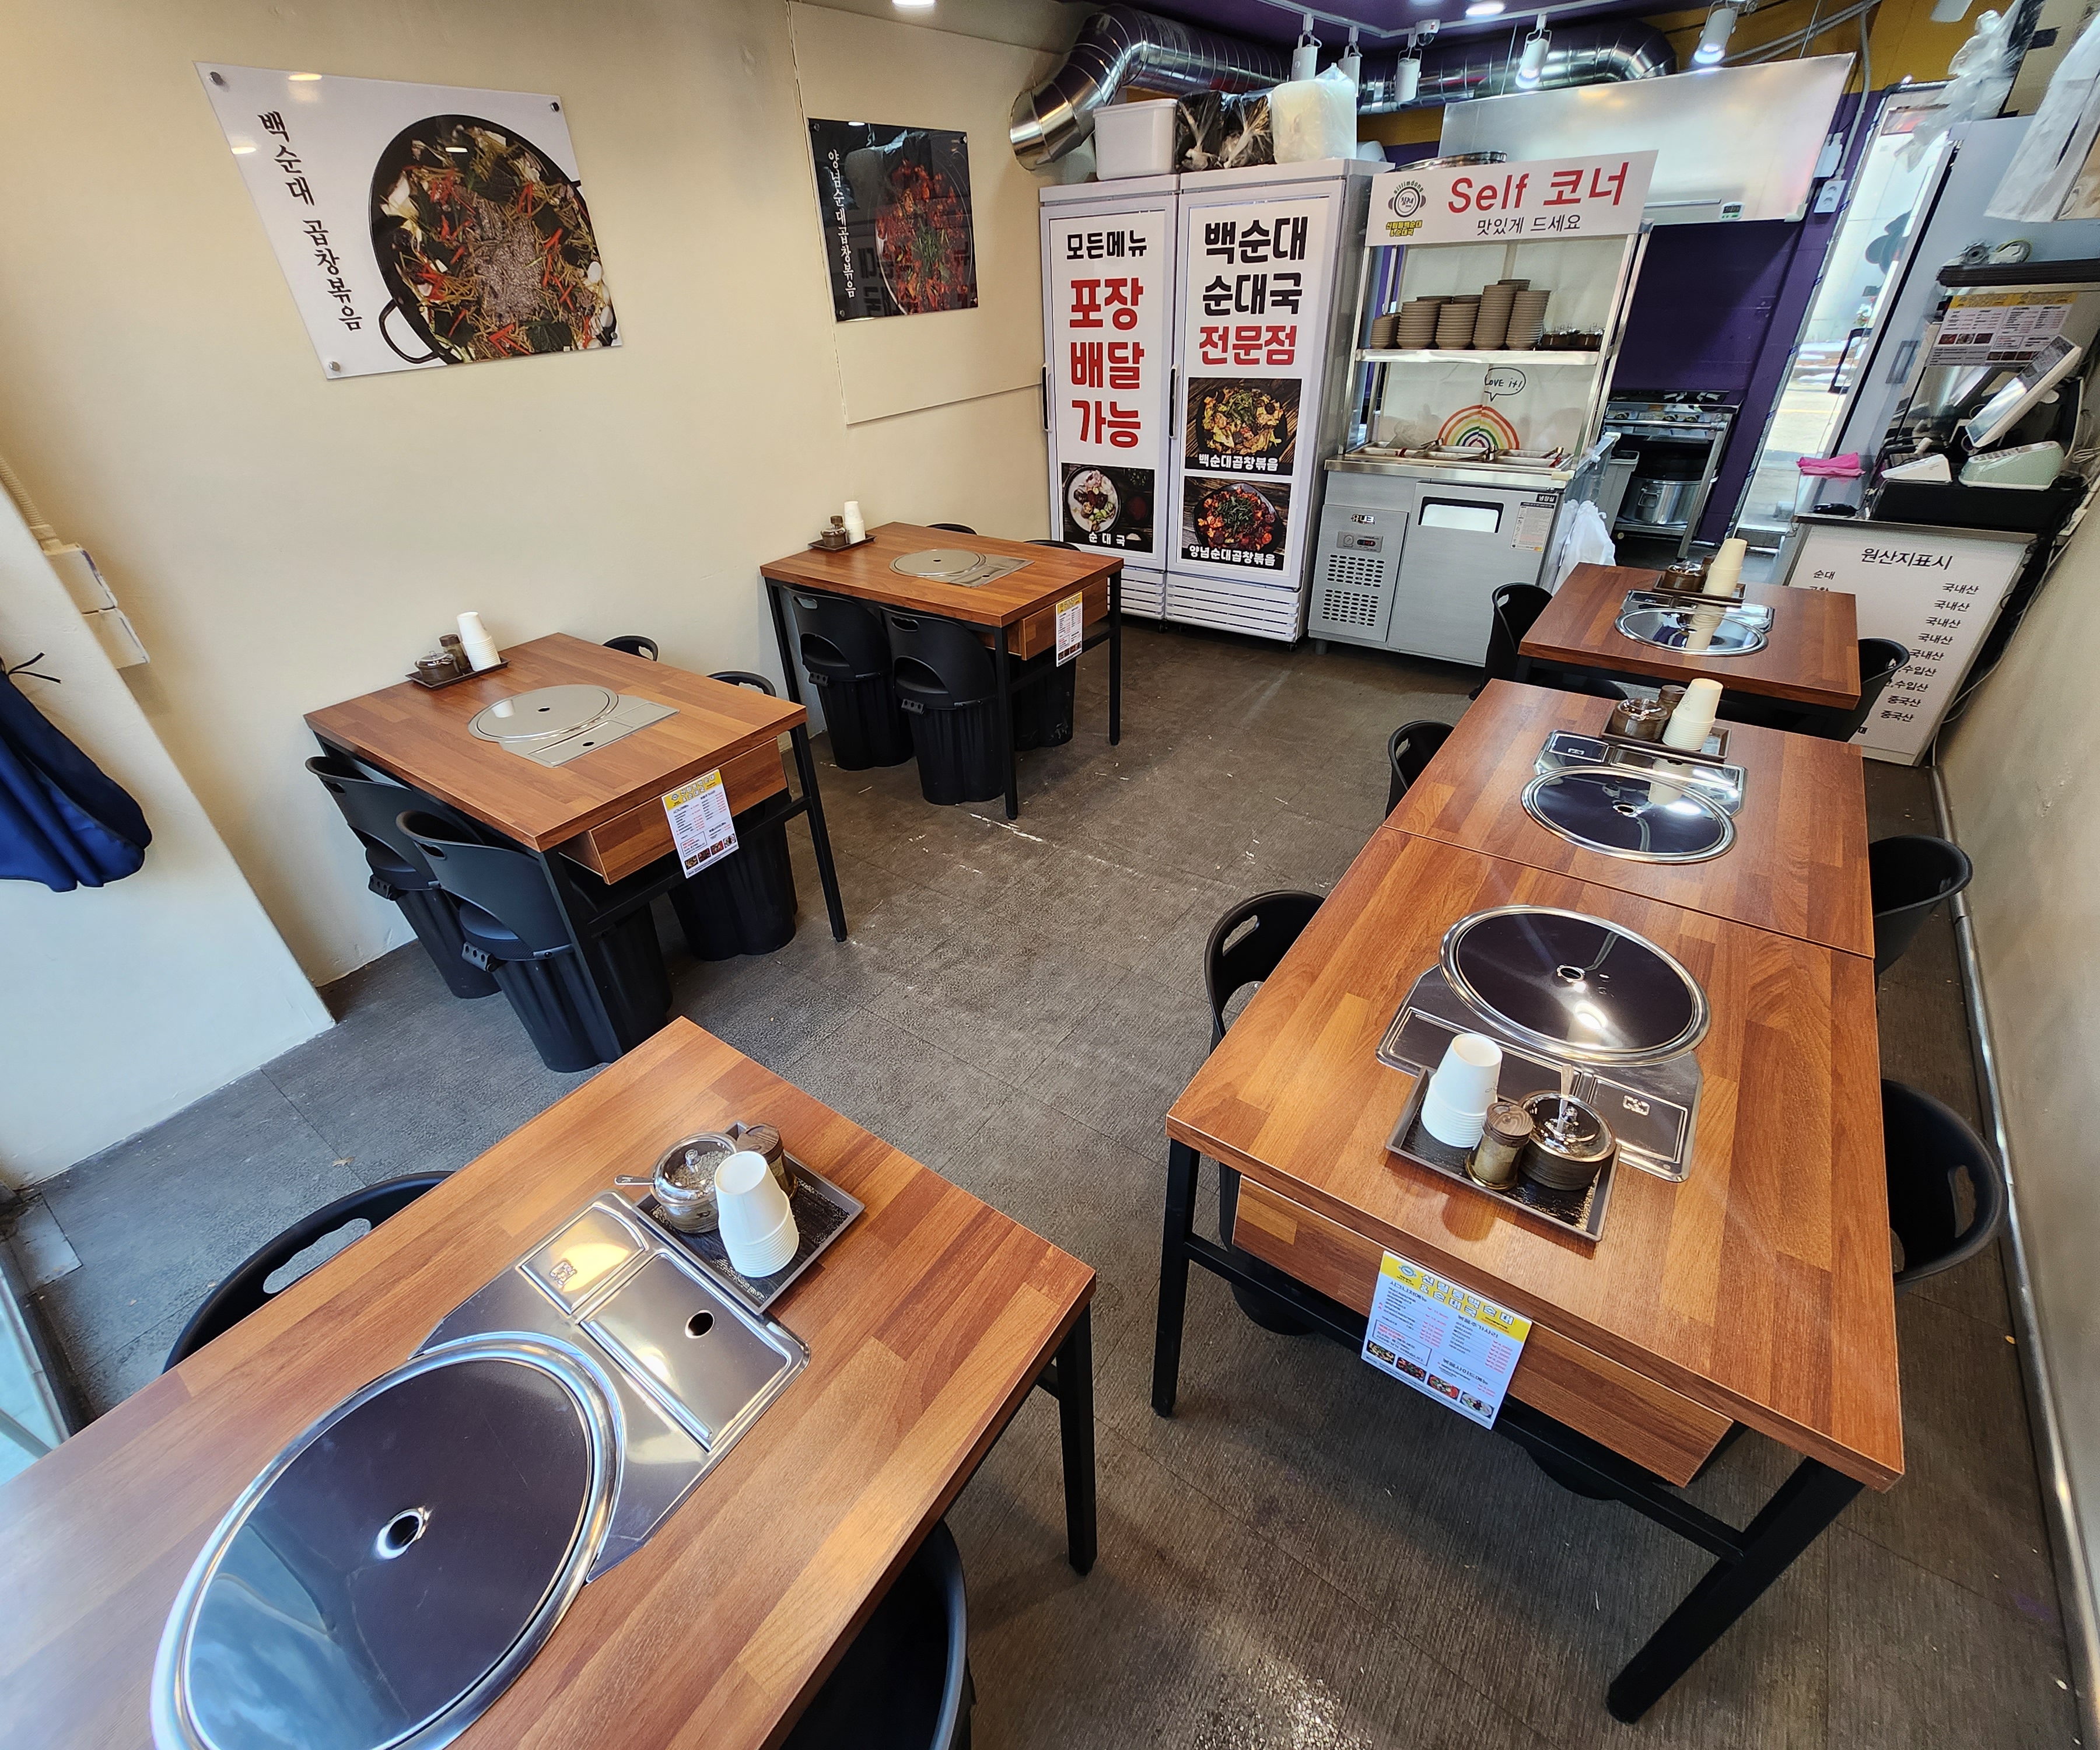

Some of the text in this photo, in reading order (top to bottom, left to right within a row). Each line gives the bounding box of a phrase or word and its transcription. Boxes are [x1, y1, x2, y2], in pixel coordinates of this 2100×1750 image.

[1448, 162, 1629, 214] Self 코너
[257, 110, 362, 331] 백순대 곱창볶음
[828, 148, 856, 299] 양념순대곱창볶음
[1477, 214, 1581, 236] 맛있게 드세요
[1066, 230, 1147, 260] 모든메뉴
[1204, 216, 1308, 264] 백순대
[1070, 277, 1143, 331] 포장
[1203, 272, 1303, 316] 순대국
[1199, 326, 1297, 365] 전문점
[1070, 341, 1144, 390] 배달
[1071, 400, 1141, 449] 가능
[1199, 454, 1278, 471] 백순대곱창볶음
[1088, 531, 1125, 547] 순대국
[1189, 545, 1276, 566] 양념순대곱창볶음
[1861, 547, 1953, 570] 원산지표시
[1813, 569, 1836, 580] 순대
[1943, 583, 1979, 595] 국내산
[1934, 600, 1971, 612] 국내산
[1926, 616, 1961, 629] 국내산
[1917, 633, 1954, 646] 국내산
[1909, 649, 1944, 662] 국내산
[1888, 695, 1921, 707] 중국산
[1880, 709, 1914, 722] 중국산
